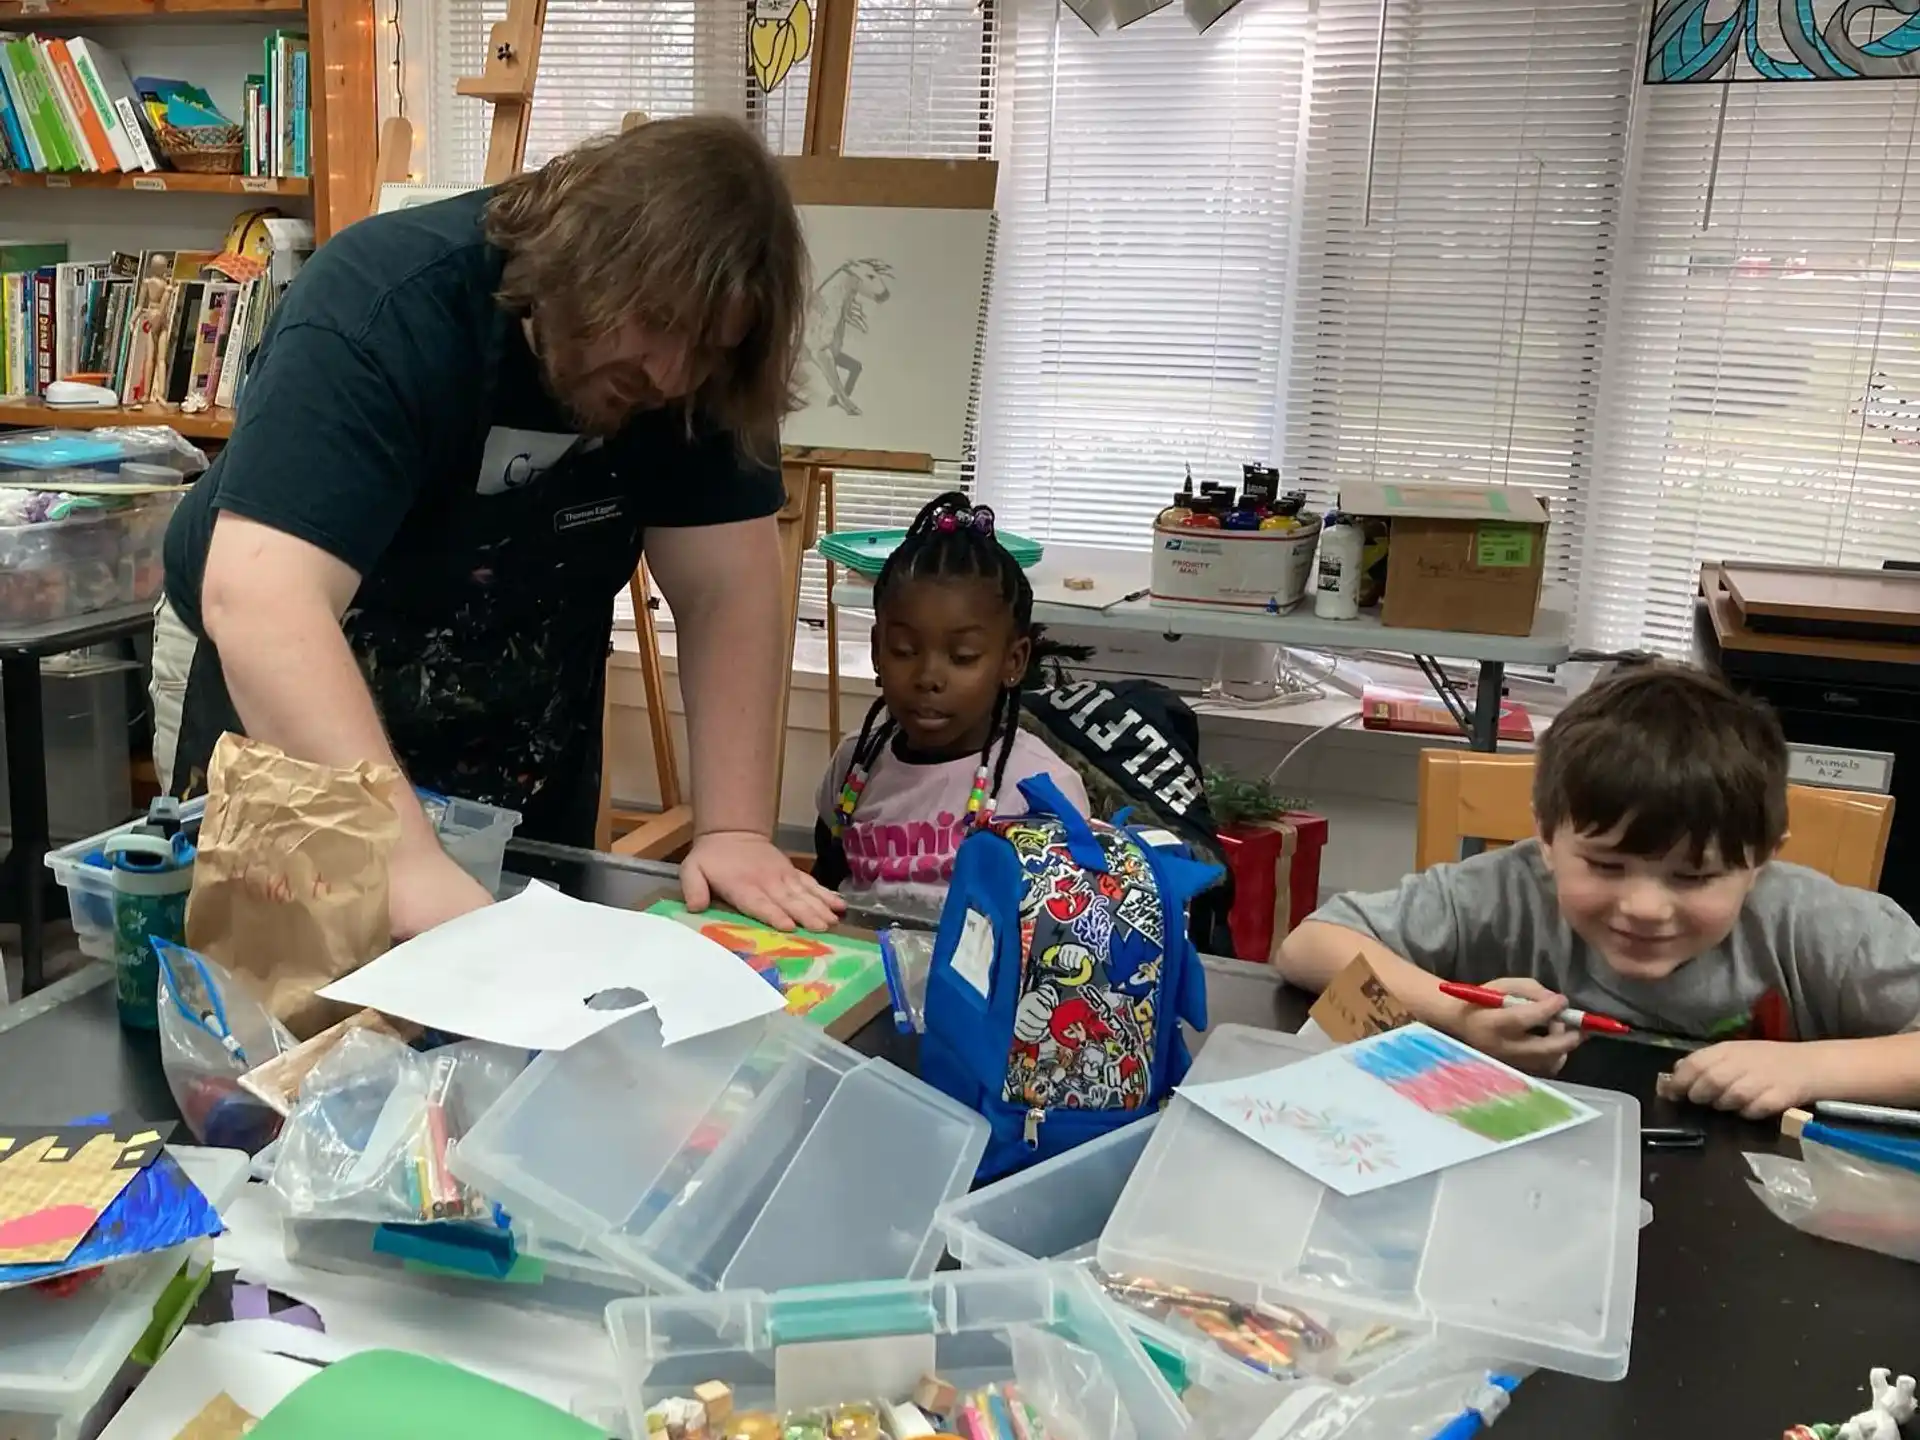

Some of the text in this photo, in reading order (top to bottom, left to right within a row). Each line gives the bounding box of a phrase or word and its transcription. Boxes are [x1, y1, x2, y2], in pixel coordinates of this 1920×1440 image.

[1171, 559, 1211, 570] PRIORITY
[1804, 754, 1860, 770] Animals
[1818, 767, 1842, 778] A-Z
